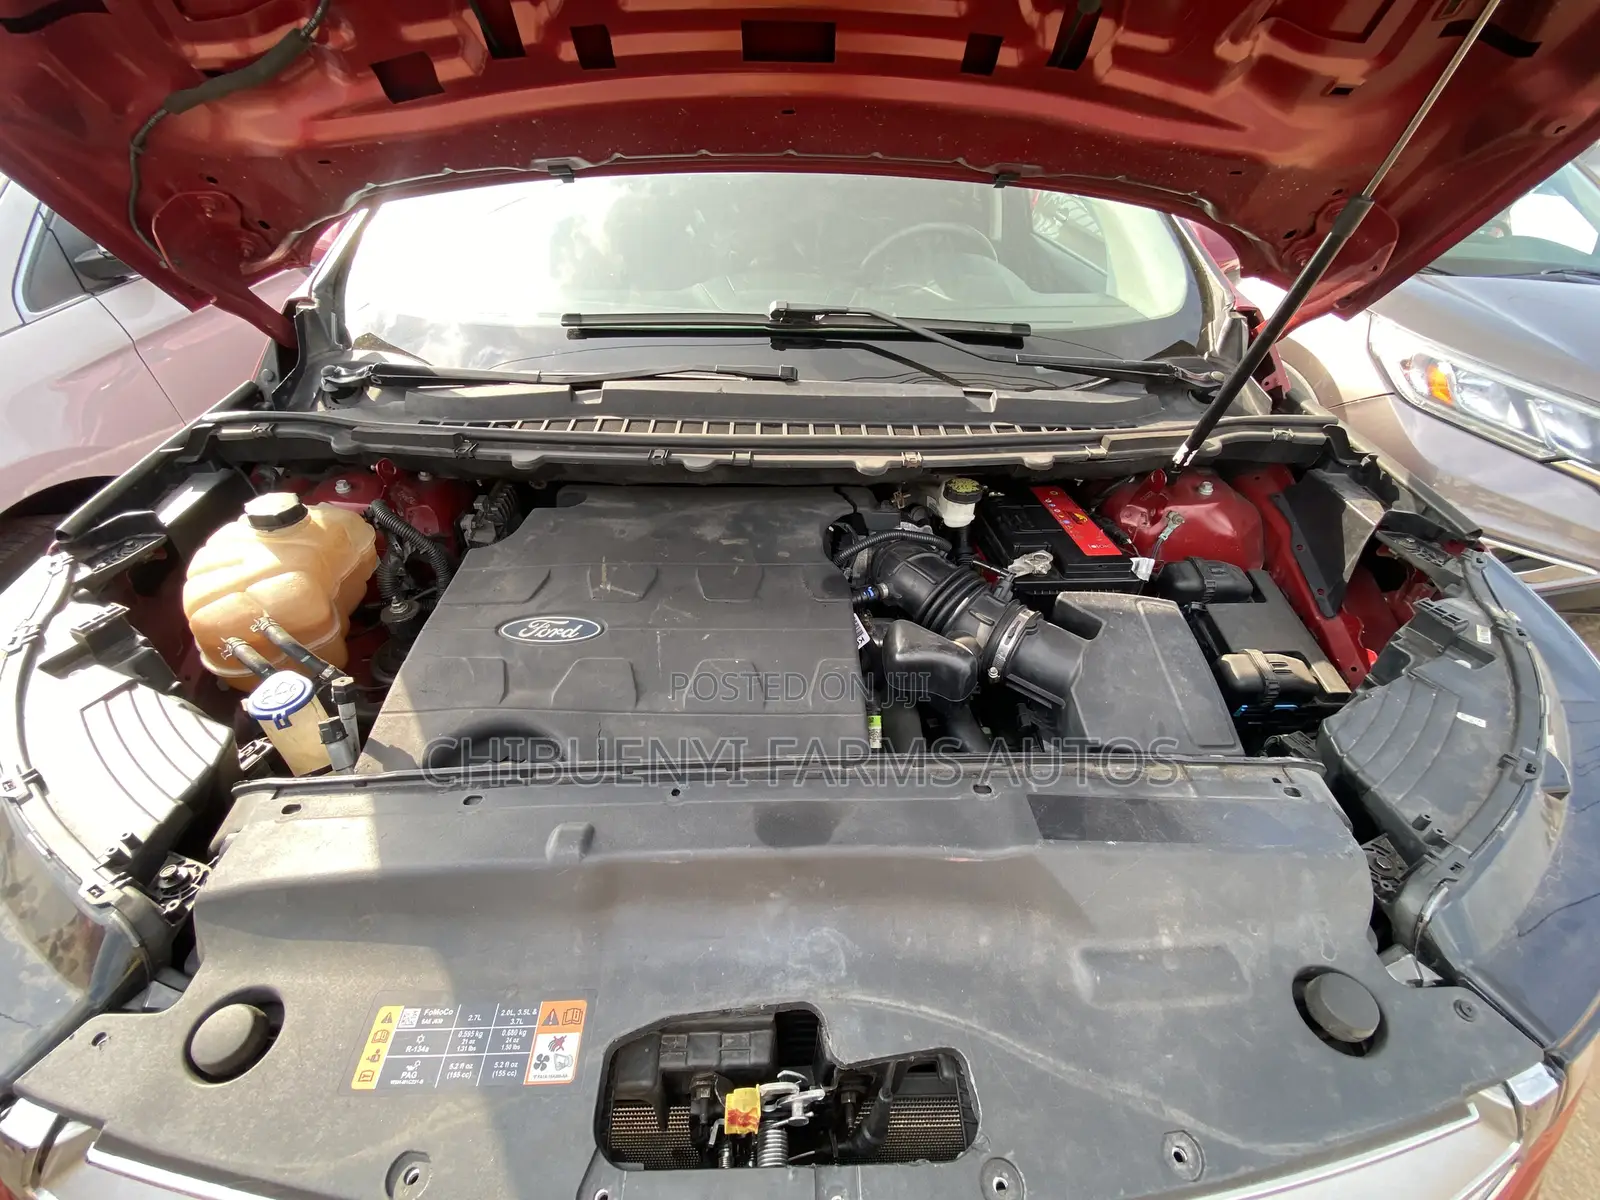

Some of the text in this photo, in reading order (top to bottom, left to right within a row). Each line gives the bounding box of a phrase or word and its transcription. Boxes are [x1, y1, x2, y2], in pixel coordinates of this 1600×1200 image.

[518, 619, 583, 638] Ford
[423, 1008, 454, 1016] FoMoCo
[467, 1014, 482, 1022] 2.7L
[519, 1029, 528, 1038] kg
[405, 1045, 430, 1053] R-134a
[400, 1071, 418, 1079] PAG
